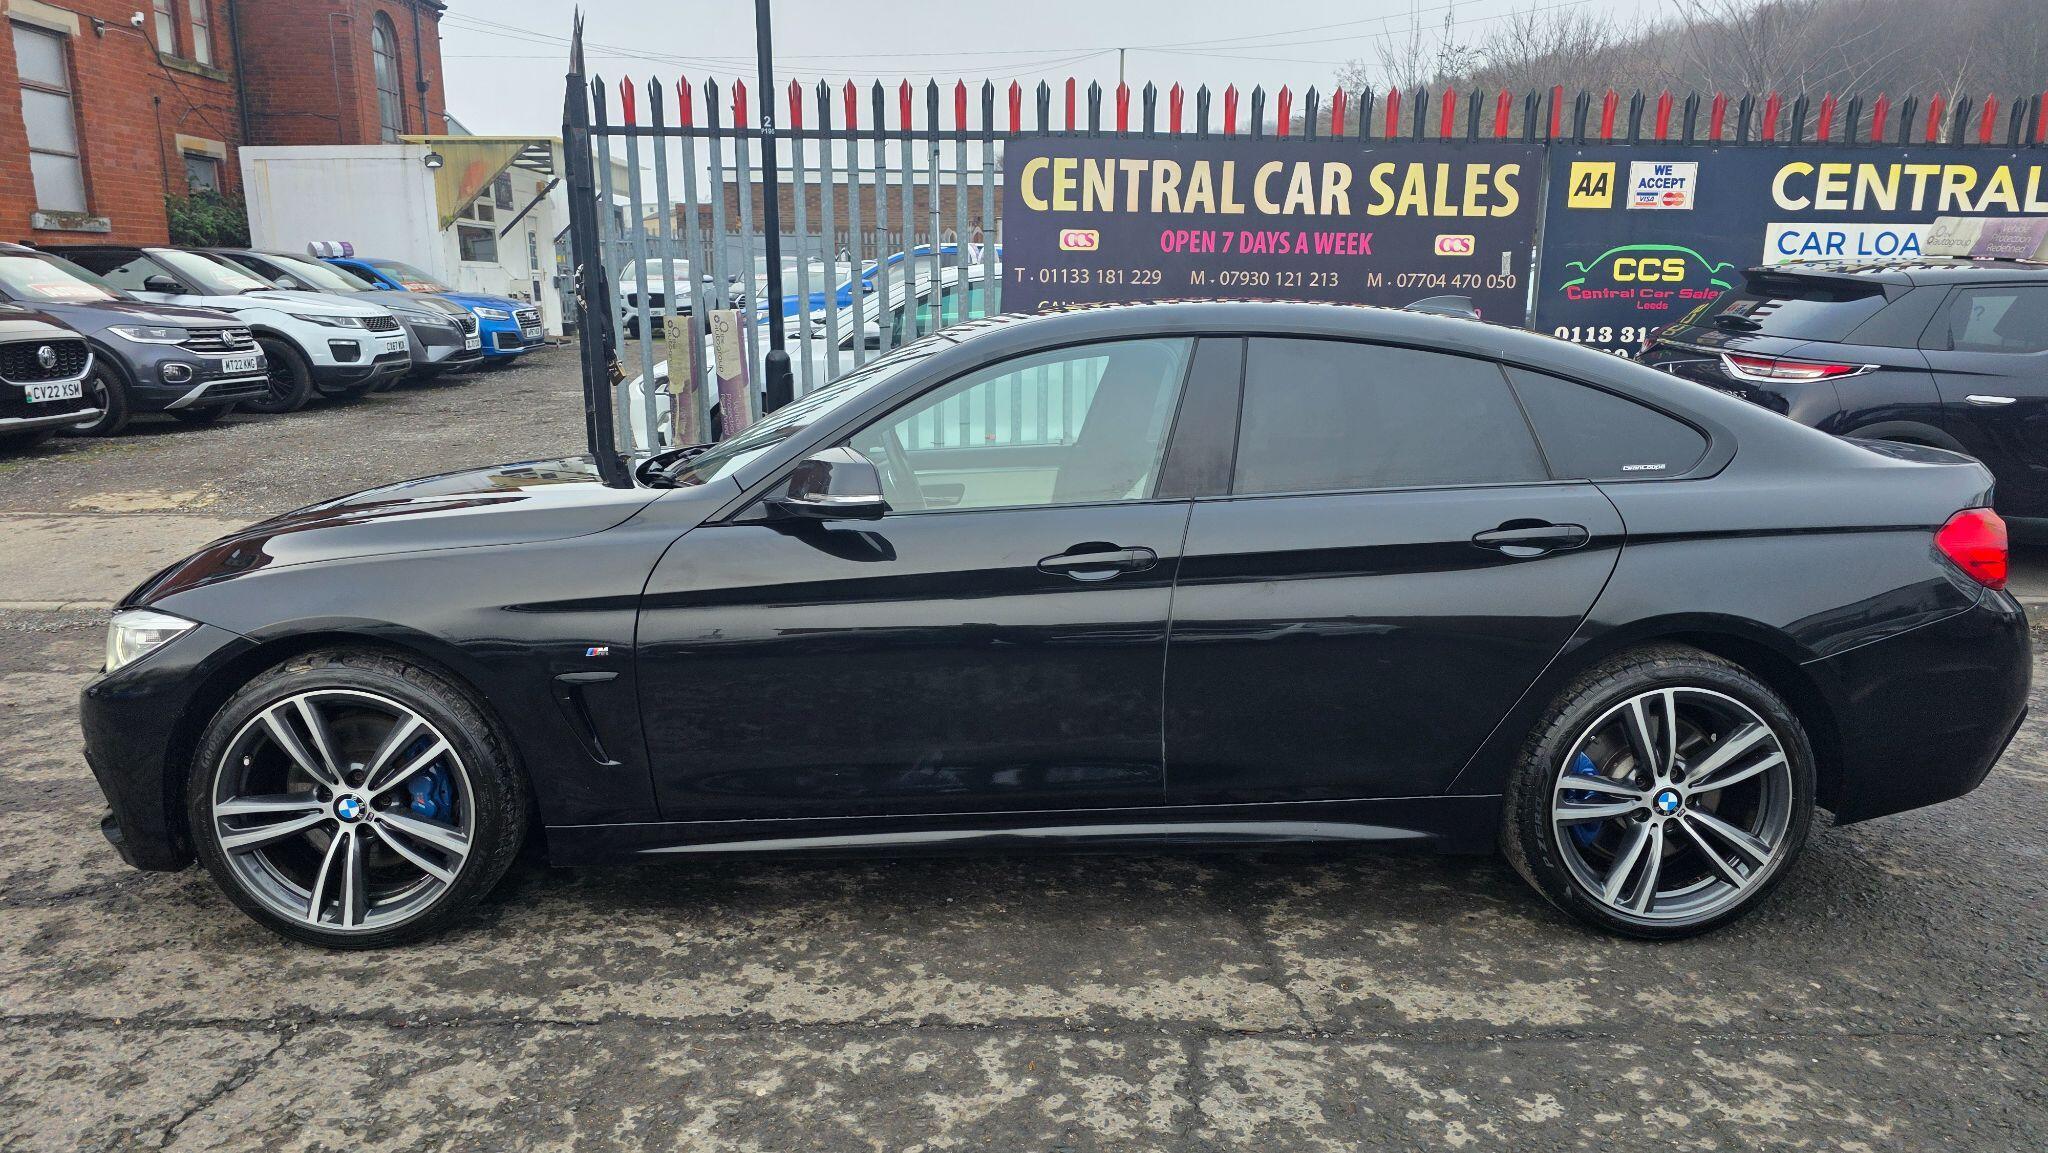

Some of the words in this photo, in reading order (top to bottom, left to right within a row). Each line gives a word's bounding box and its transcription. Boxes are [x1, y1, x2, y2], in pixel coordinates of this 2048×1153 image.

[763, 115, 772, 127] 2
[1654, 165, 1673, 175] WE
[1021, 157, 1245, 214] CENTRAL
[1253, 161, 1353, 215] CAR
[1367, 162, 1521, 217] SALES
[1573, 172, 1608, 197] AA
[1638, 177, 1686, 189] ACCEPT
[1771, 161, 2048, 213] CENTRAL
[1063, 232, 1095, 248] CCS
[1160, 230, 1216, 253] OPEN
[1221, 231, 1235, 253] 7
[1240, 231, 1290, 254] DAYS
[1294, 231, 1309, 254] A
[1314, 232, 1374, 255] WEEK
[1438, 237, 1471, 253] CCS
[1777, 230, 1847, 256] CAR
[1857, 231, 1922, 256] LOA
[1039, 268, 1090, 284] 01133
[1097, 269, 1123, 284] 181
[1130, 269, 1162, 285] 229
[1613, 257, 1686, 282] CCS
[1219, 270, 1270, 286] 07930
[1276, 271, 1302, 287] 121
[1309, 271, 1339, 287] 213
[1396, 273, 1447, 288] 07704
[1451, 274, 1481, 289] 470
[1486, 274, 1517, 289] 050
[1566, 285, 1635, 300] Central
[1639, 288, 1675, 299] Car
[1678, 288, 1720, 300] Sale
[1636, 300, 1669, 310] Leeds
[1554, 326, 1613, 343] 0113
[1620, 326, 1662, 343] 31
[33, 385, 60, 400] CV22
[62, 382, 81, 397] XSM
